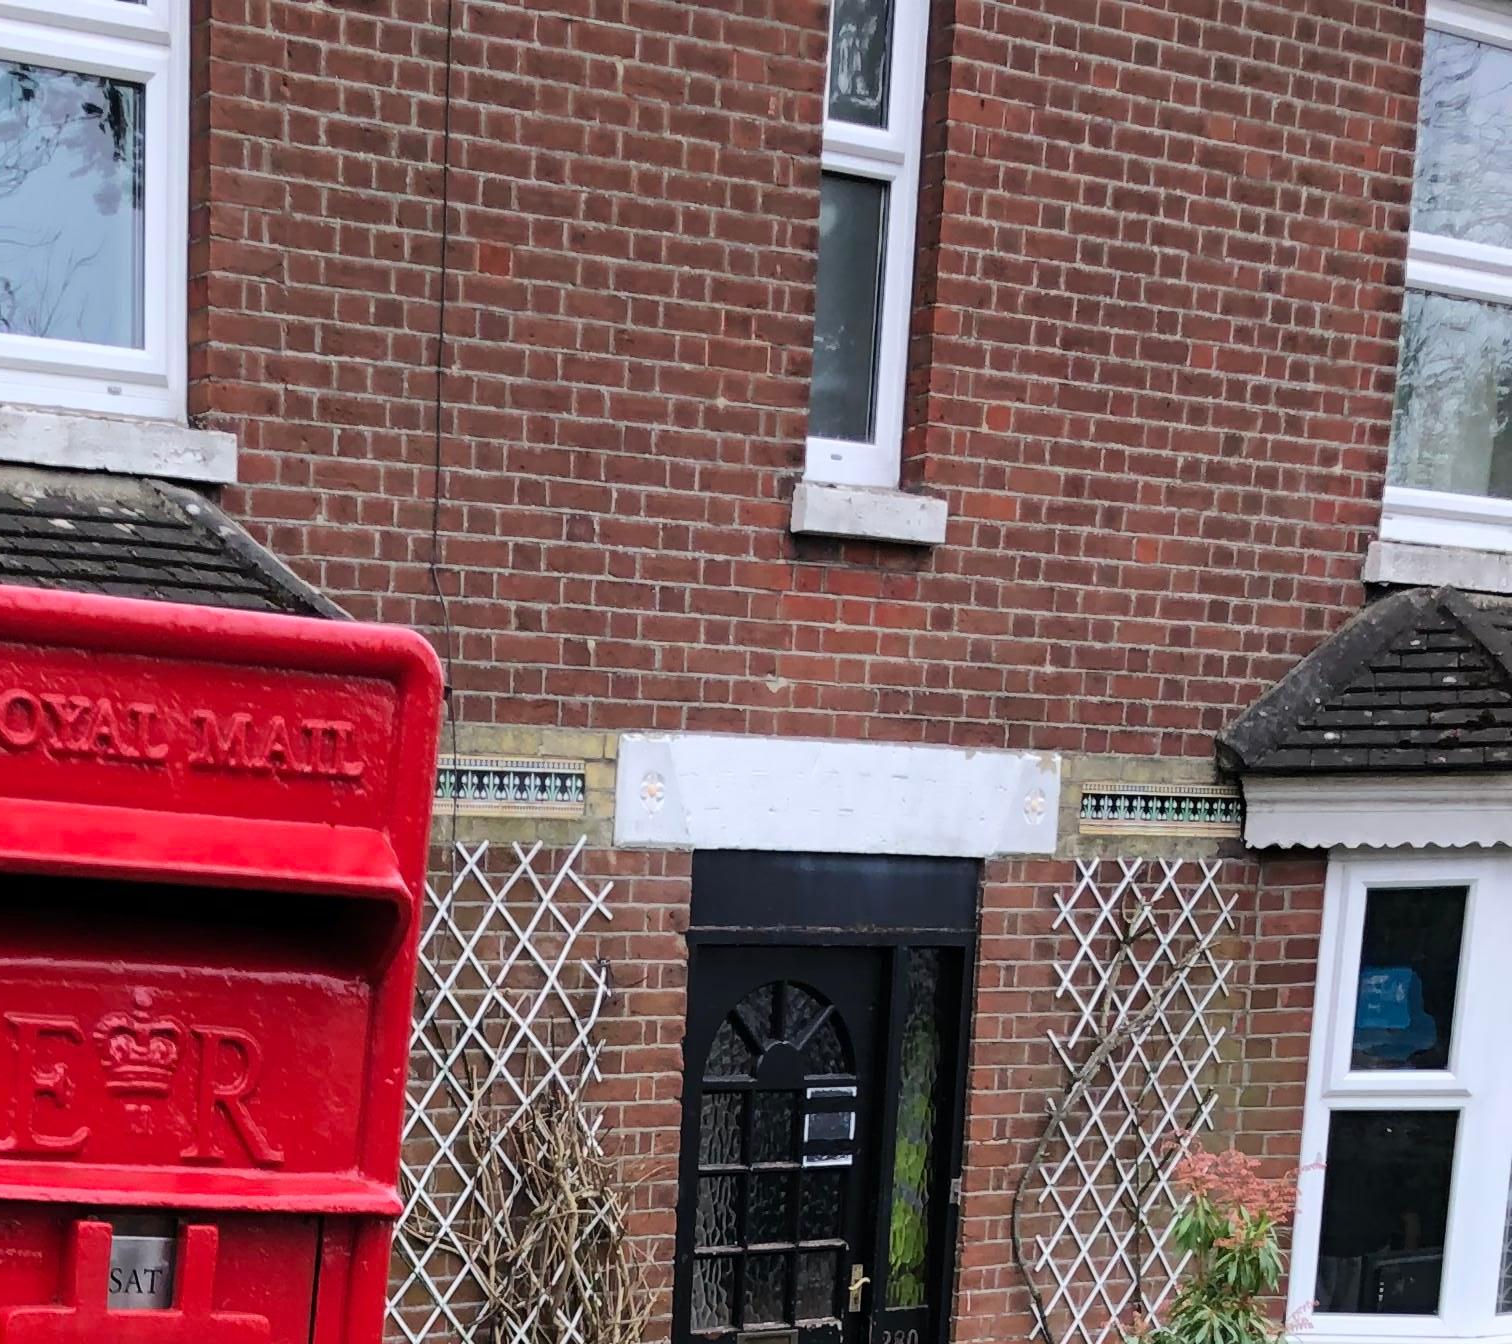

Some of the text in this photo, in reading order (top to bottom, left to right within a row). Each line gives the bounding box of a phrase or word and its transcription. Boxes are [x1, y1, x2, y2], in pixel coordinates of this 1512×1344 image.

[188, 709, 365, 779] MAIL
[180, 1024, 285, 1164] R
[109, 1268, 163, 1295] SAT
